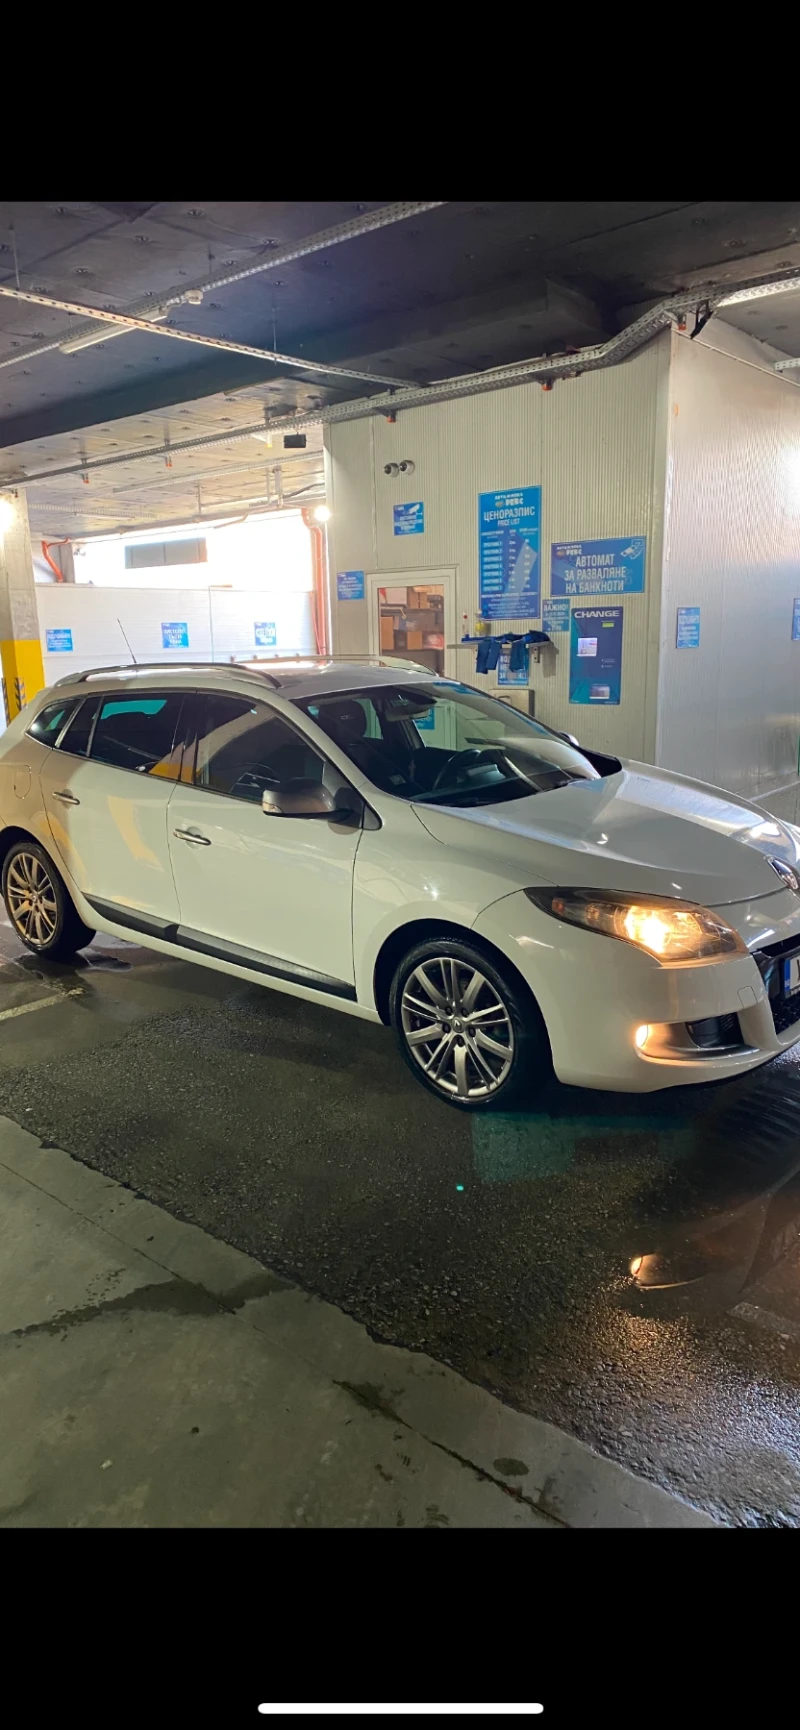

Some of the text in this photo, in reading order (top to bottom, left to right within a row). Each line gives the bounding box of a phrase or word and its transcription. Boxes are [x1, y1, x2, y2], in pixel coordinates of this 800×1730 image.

[483, 506, 535, 522] ЦЕНОРАЗПИС
[576, 553, 615, 567] АВТОМАТ
[564, 566, 627, 581] ЗА РАЗВАЛЯНЕ
[565, 580, 624, 594] НА БАНКНОТИ
[574, 610, 620, 618] CHANGE
